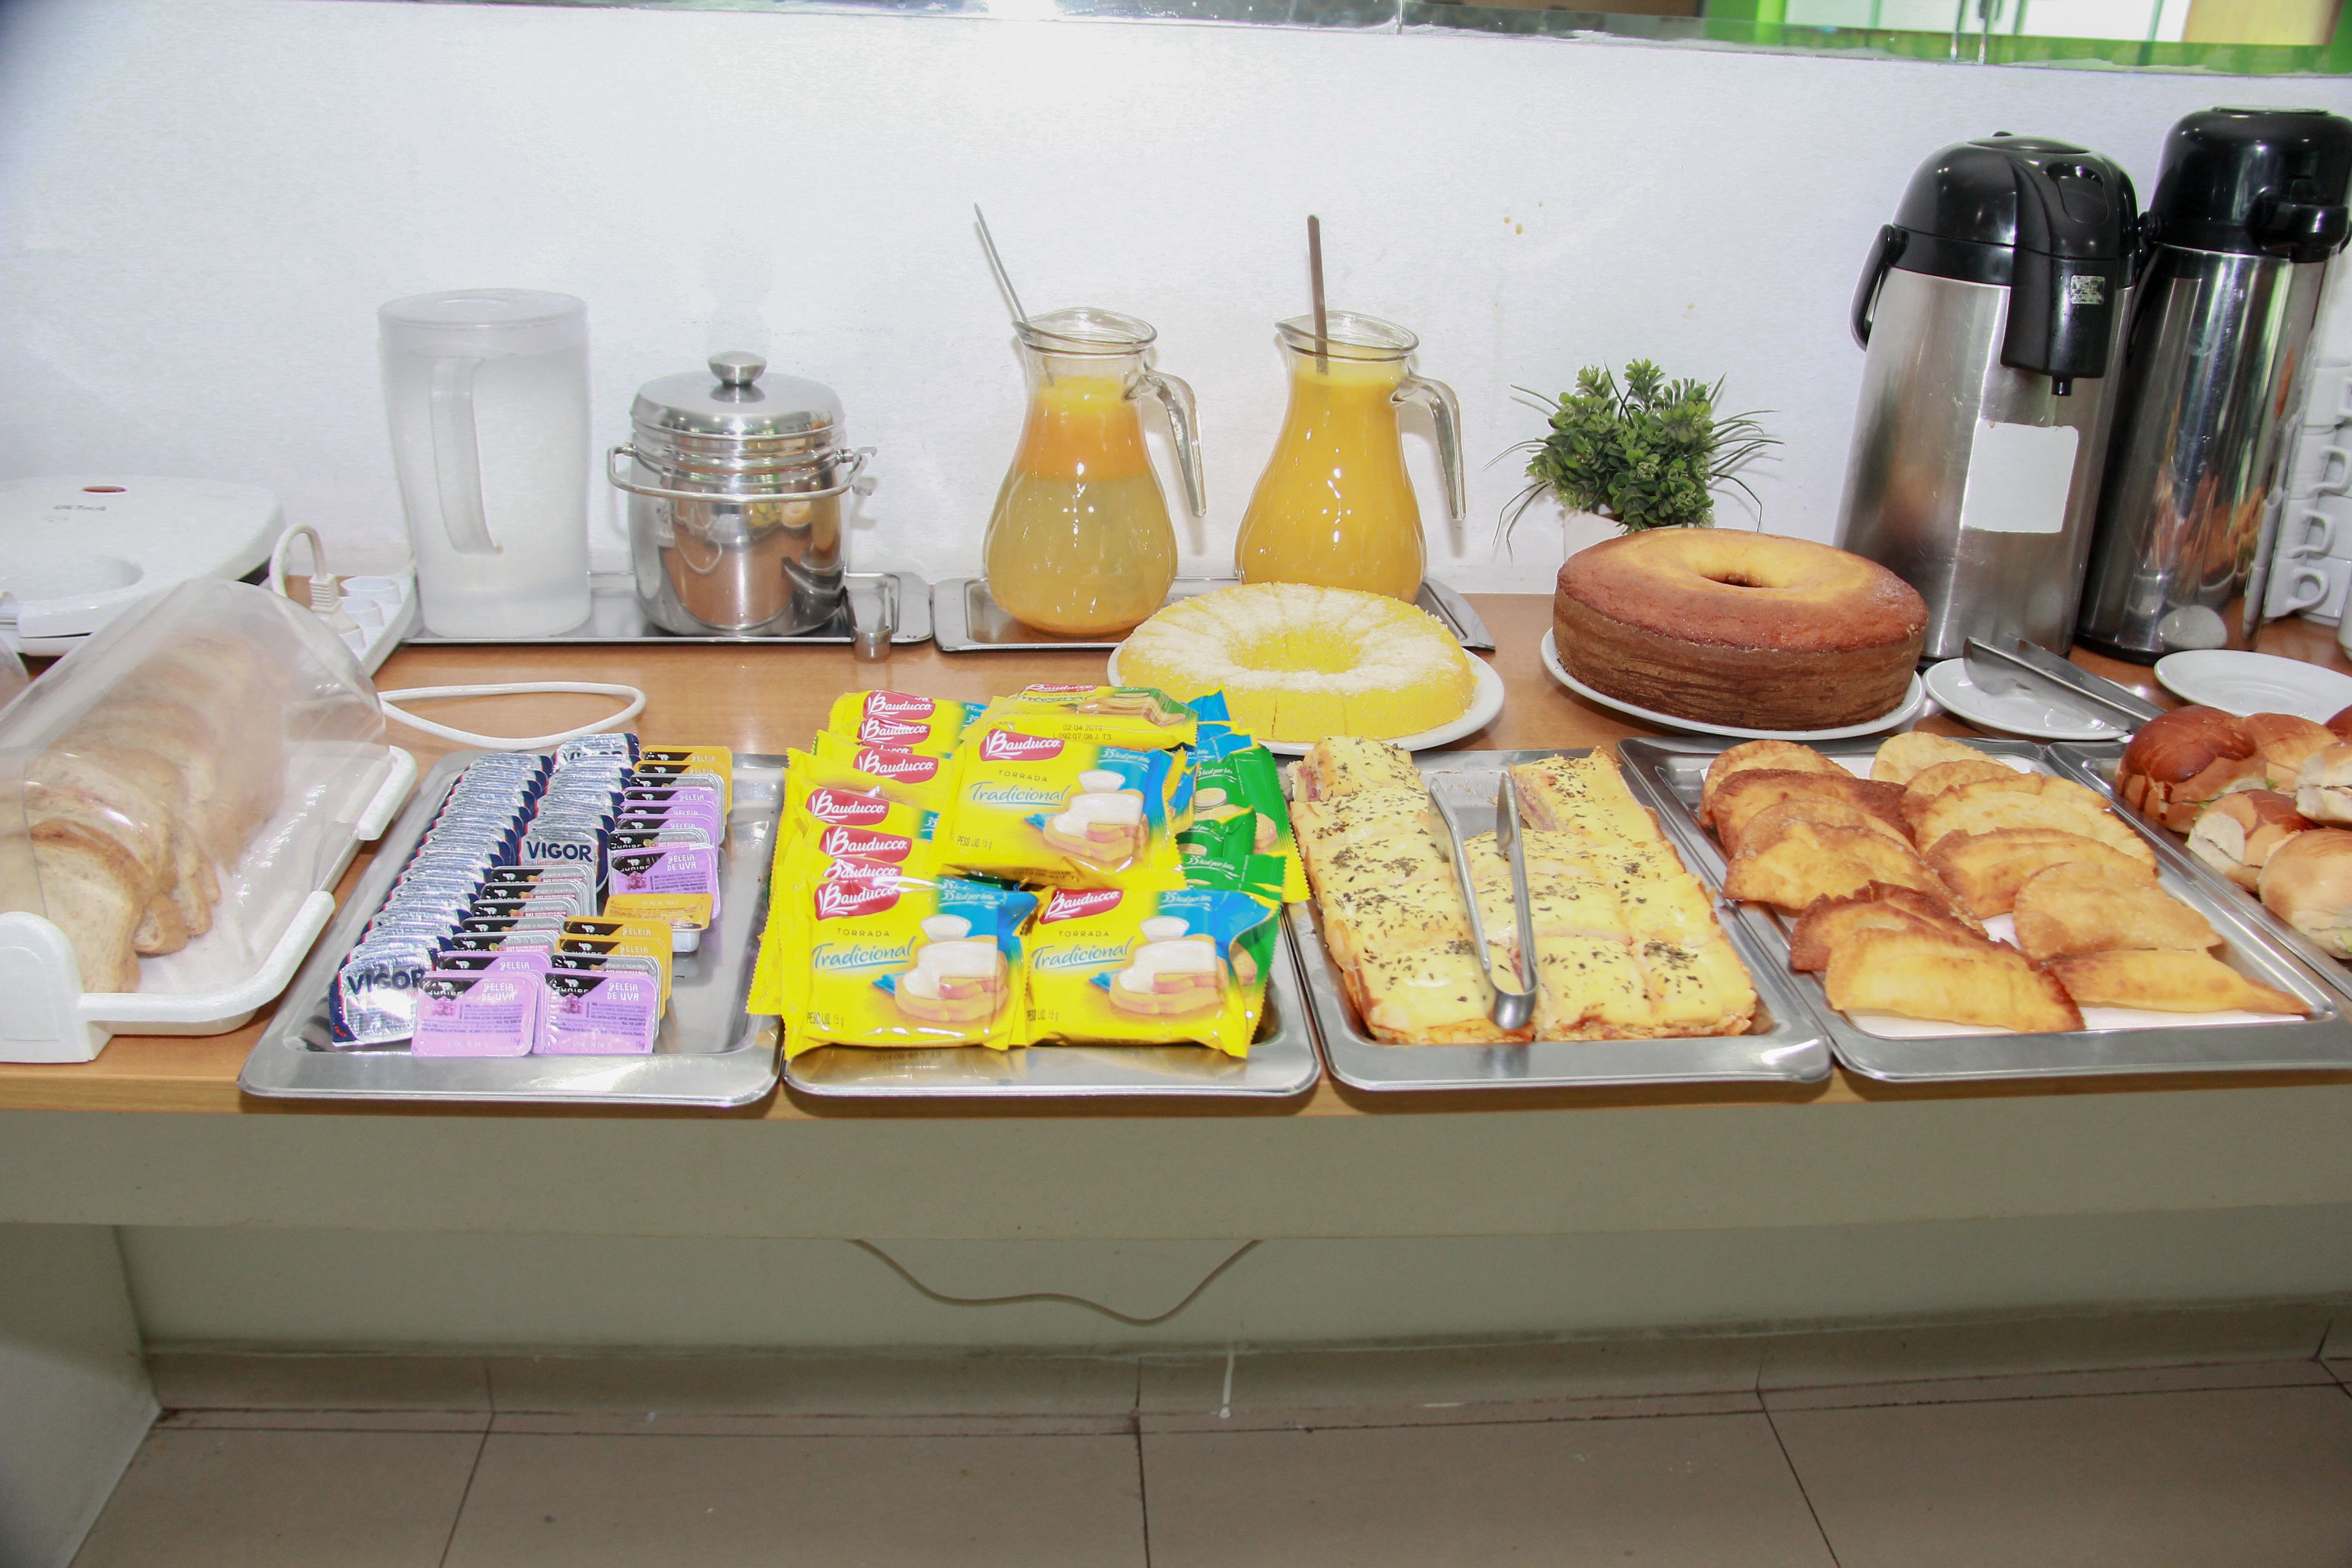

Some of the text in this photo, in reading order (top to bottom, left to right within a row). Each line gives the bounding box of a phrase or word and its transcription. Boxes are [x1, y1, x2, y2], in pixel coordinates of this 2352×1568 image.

[867, 693, 932, 716] Bauducco
[861, 717, 927, 741] Bauducco
[986, 729, 1061, 757] Bauducco
[1101, 748, 1117, 758] 35
[859, 749, 935, 774] Bauducco
[999, 770, 1048, 782] TORRADA
[970, 782, 1072, 802] Tradicional
[812, 790, 886, 817] Bauducco
[526, 840, 593, 863] VIGOR
[826, 826, 908, 856] Bauducco
[957, 835, 971, 846] PESO
[679, 861, 696, 870] UVA
[823, 858, 899, 879] Bauducco
[1185, 855, 1201, 865] 35
[818, 882, 897, 915] Bauducco
[941, 890, 956, 900] 35
[1044, 890, 1120, 921] Bauducco
[837, 928, 890, 937] TORRADA
[812, 936, 917, 968] Tradicional
[1031, 937, 1135, 970] Tradicional
[347, 969, 427, 995] VIGOR
[481, 990, 515, 1002] DE UVA
[607, 992, 639, 1001] DE UVA
[807, 1011, 821, 1025] PESO
